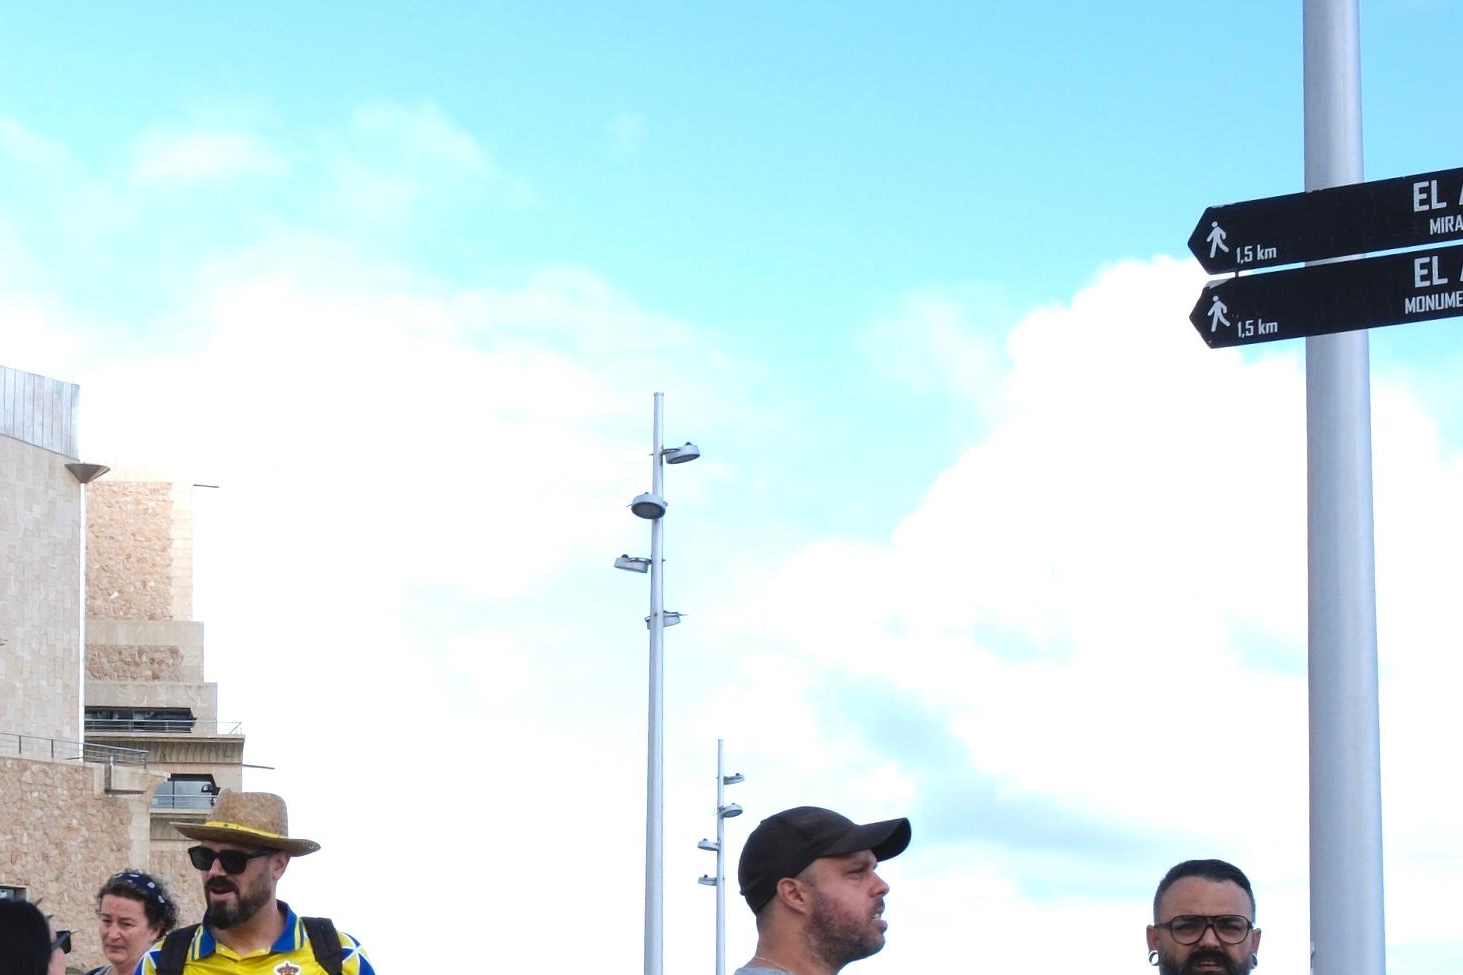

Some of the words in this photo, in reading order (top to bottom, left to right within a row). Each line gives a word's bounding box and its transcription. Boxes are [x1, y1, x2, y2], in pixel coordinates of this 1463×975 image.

[1413, 180, 1447, 212] EL
[1429, 214, 1463, 236] MIRA
[1236, 245, 1253, 264] 1,5
[1256, 244, 1277, 260] km
[1414, 256, 1448, 288] EL
[1404, 290, 1463, 315] MONUME
[1237, 320, 1254, 338] 1,5
[1258, 318, 1278, 334] km
